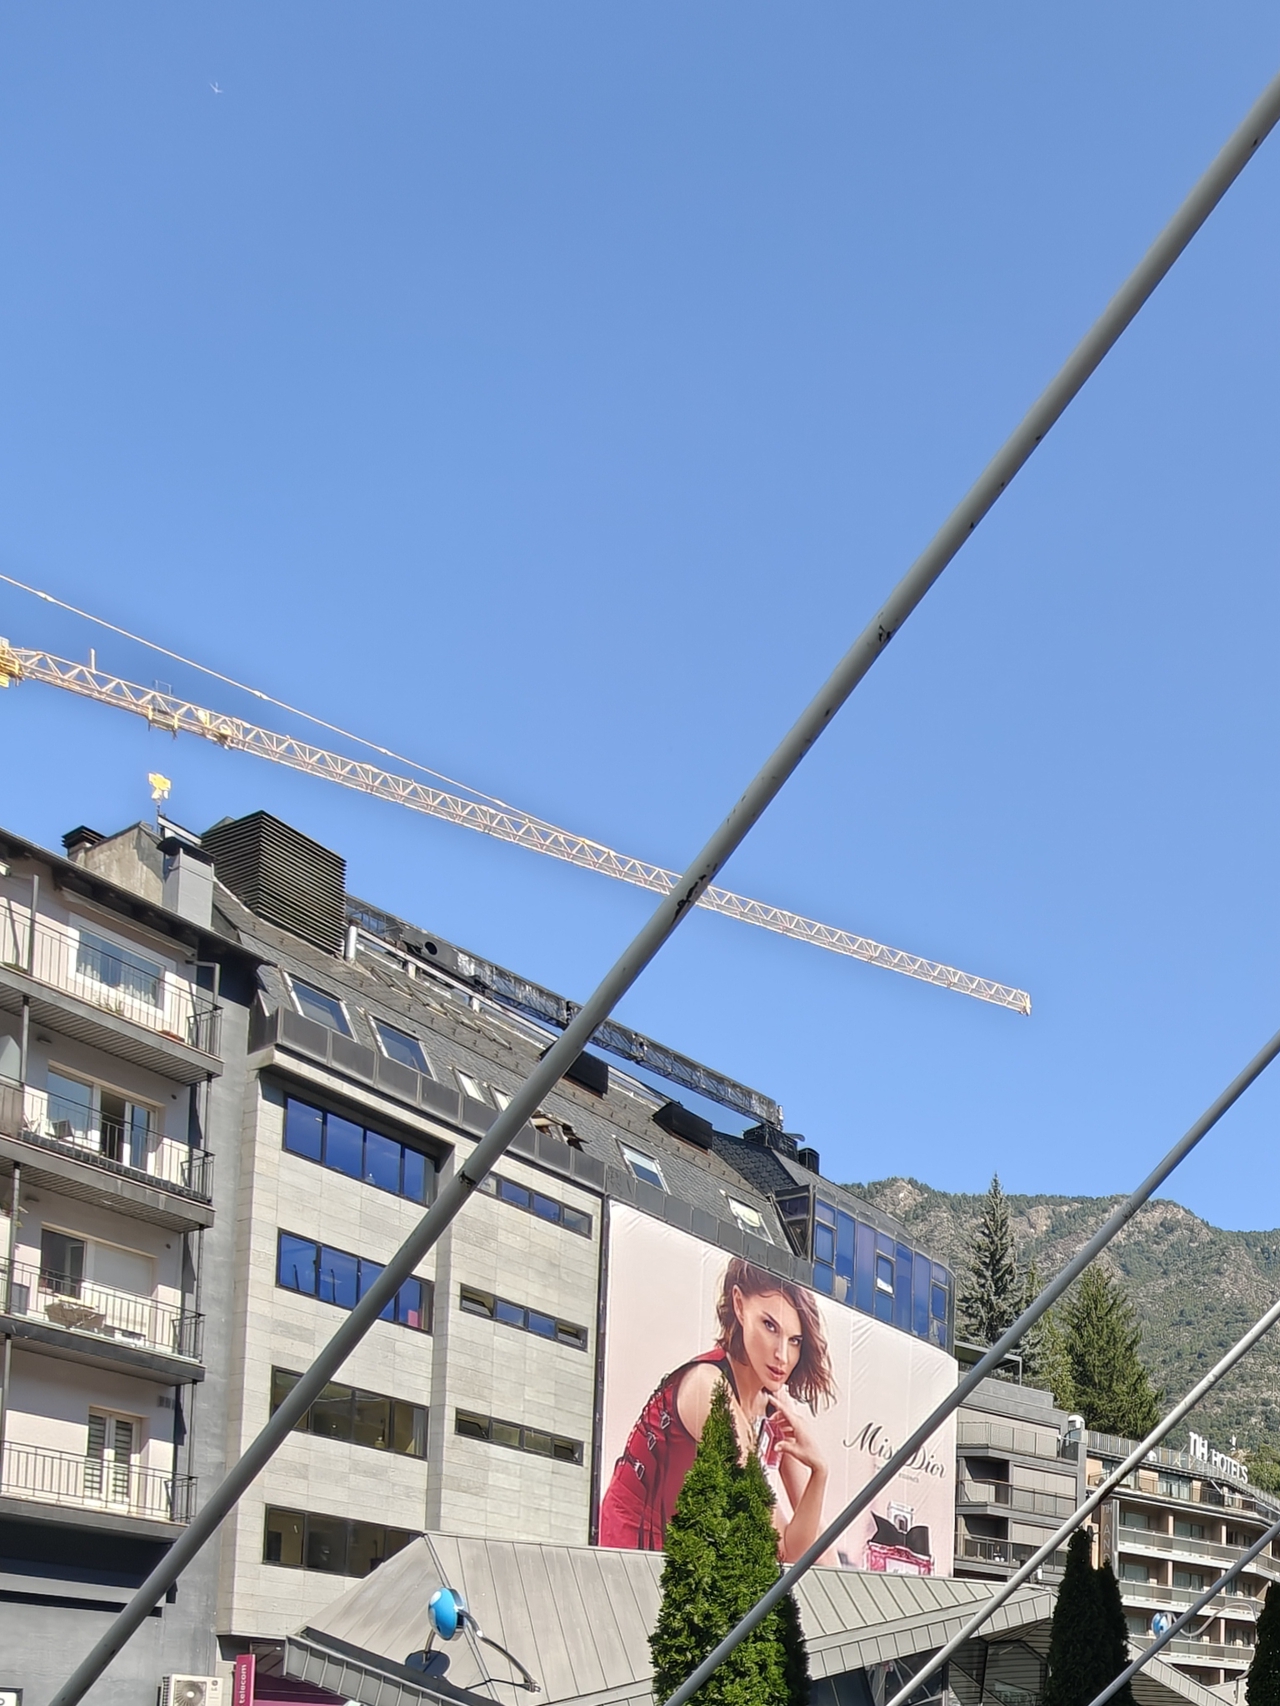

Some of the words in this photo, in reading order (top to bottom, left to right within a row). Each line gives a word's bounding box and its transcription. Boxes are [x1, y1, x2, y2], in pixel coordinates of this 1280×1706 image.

[842, 1421, 902, 1461] Mis
[904, 1445, 946, 1478] Dior
[1210, 1449, 1249, 1484] HOTELS
[238, 1664, 247, 1704] telecom
